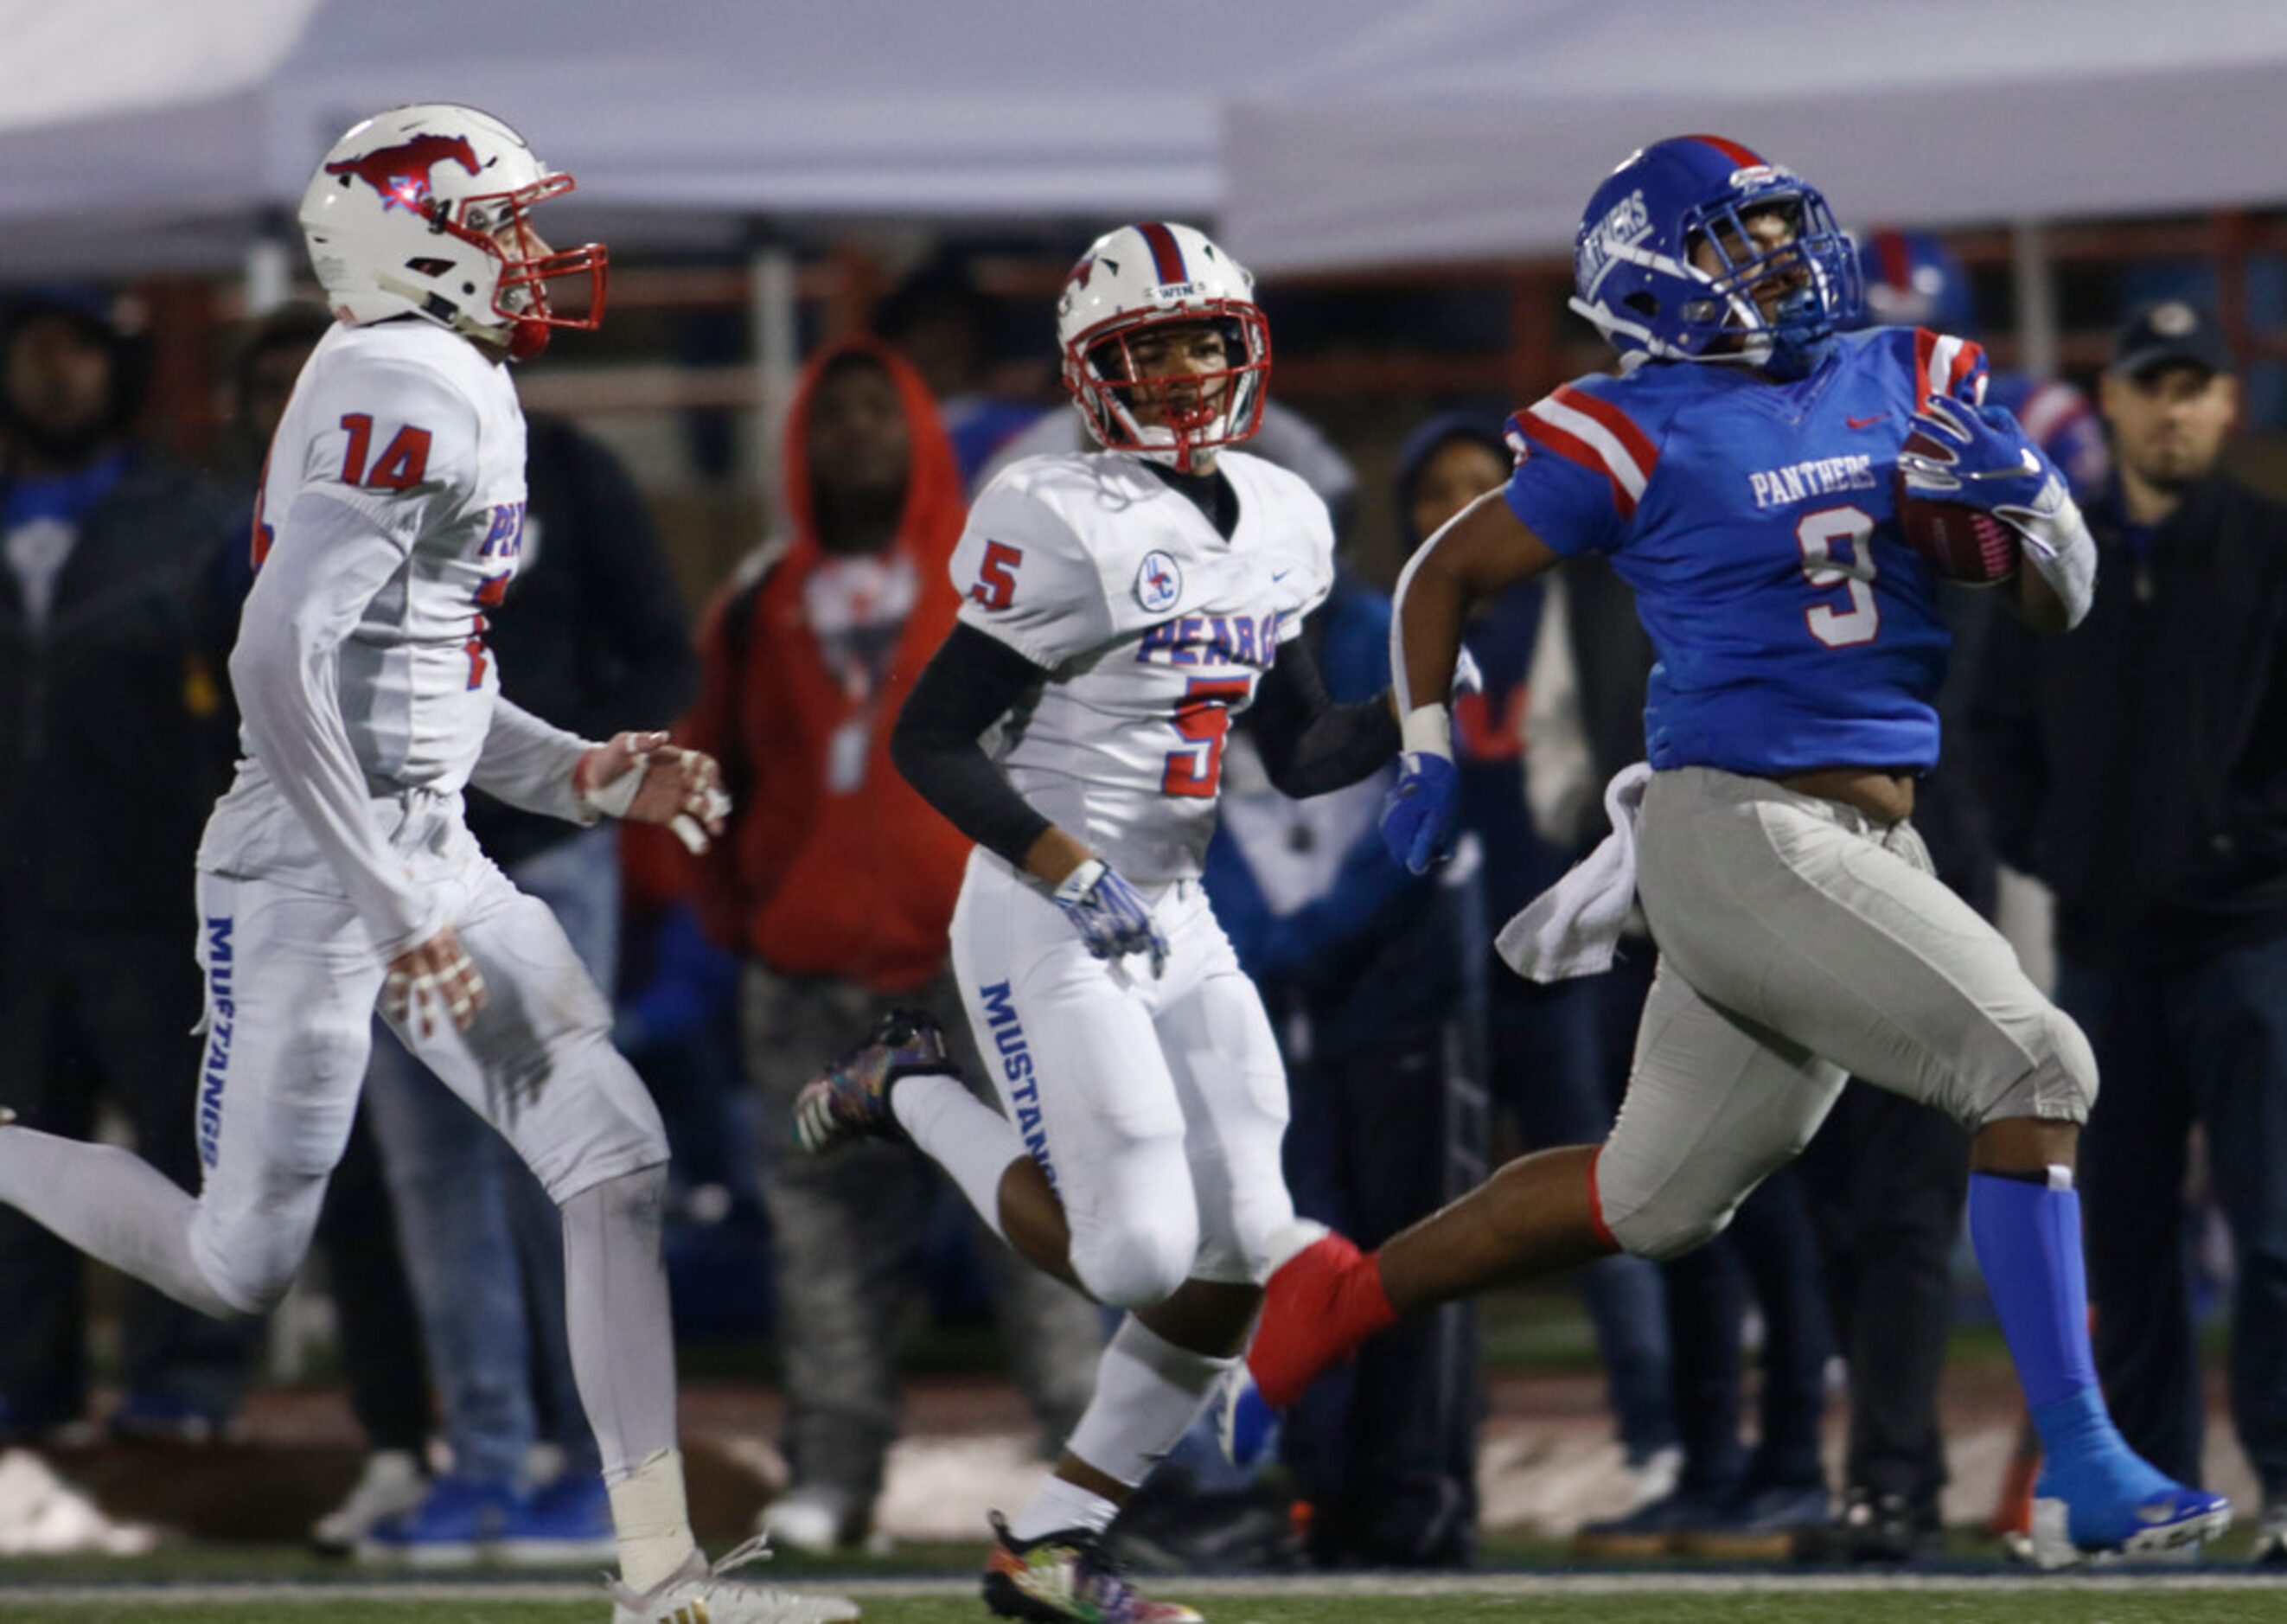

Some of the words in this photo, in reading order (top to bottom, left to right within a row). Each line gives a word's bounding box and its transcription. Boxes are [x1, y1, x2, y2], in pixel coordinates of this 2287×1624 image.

[341, 413, 432, 490] 14
[1749, 454, 1876, 508] PANTHERS
[970, 538, 1024, 611] 5
[1795, 505, 1879, 650] 9
[1161, 675, 1252, 797] 5
